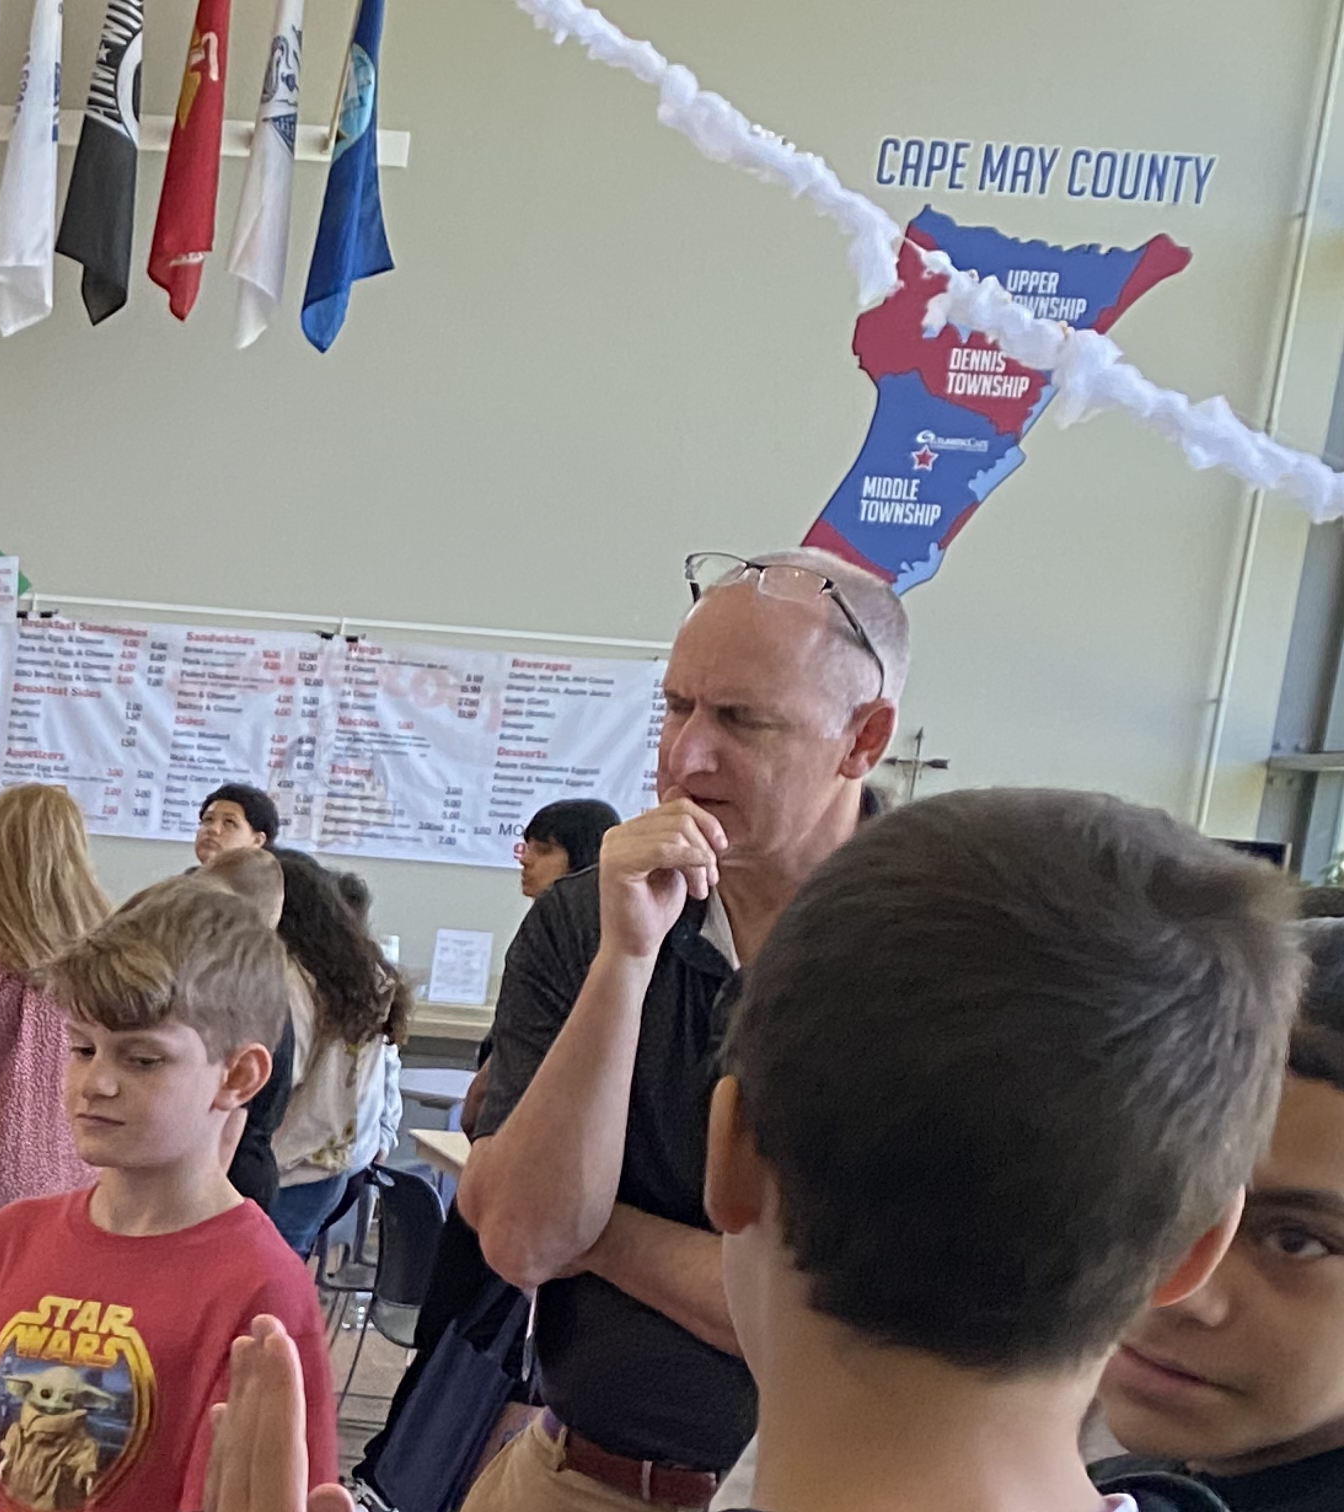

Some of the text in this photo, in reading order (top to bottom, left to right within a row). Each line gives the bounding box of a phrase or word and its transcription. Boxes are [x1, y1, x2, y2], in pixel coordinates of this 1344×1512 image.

[876, 138, 1216, 205] CAPE MAY COUNTY
[1007, 270, 1059, 294] UPPER
[1011, 294, 1087, 321] OWNSHIP
[948, 348, 1007, 372] DENNIS
[947, 372, 1030, 398] TOWNSHIP
[862, 476, 920, 500] MIDDLE
[860, 500, 941, 526] TOWNSHIP
[80, 623, 147, 637] Sandwiches
[186, 632, 255, 645] Sandwiches
[512, 658, 572, 671] Beverages
[175, 715, 206, 725] Sides
[338, 716, 380, 728] Nachos
[497, 746, 548, 759] Desserts
[498, 823, 524, 836] MO
[15, 1295, 136, 1338] STAR
[15, 1323, 120, 1368] WARS
